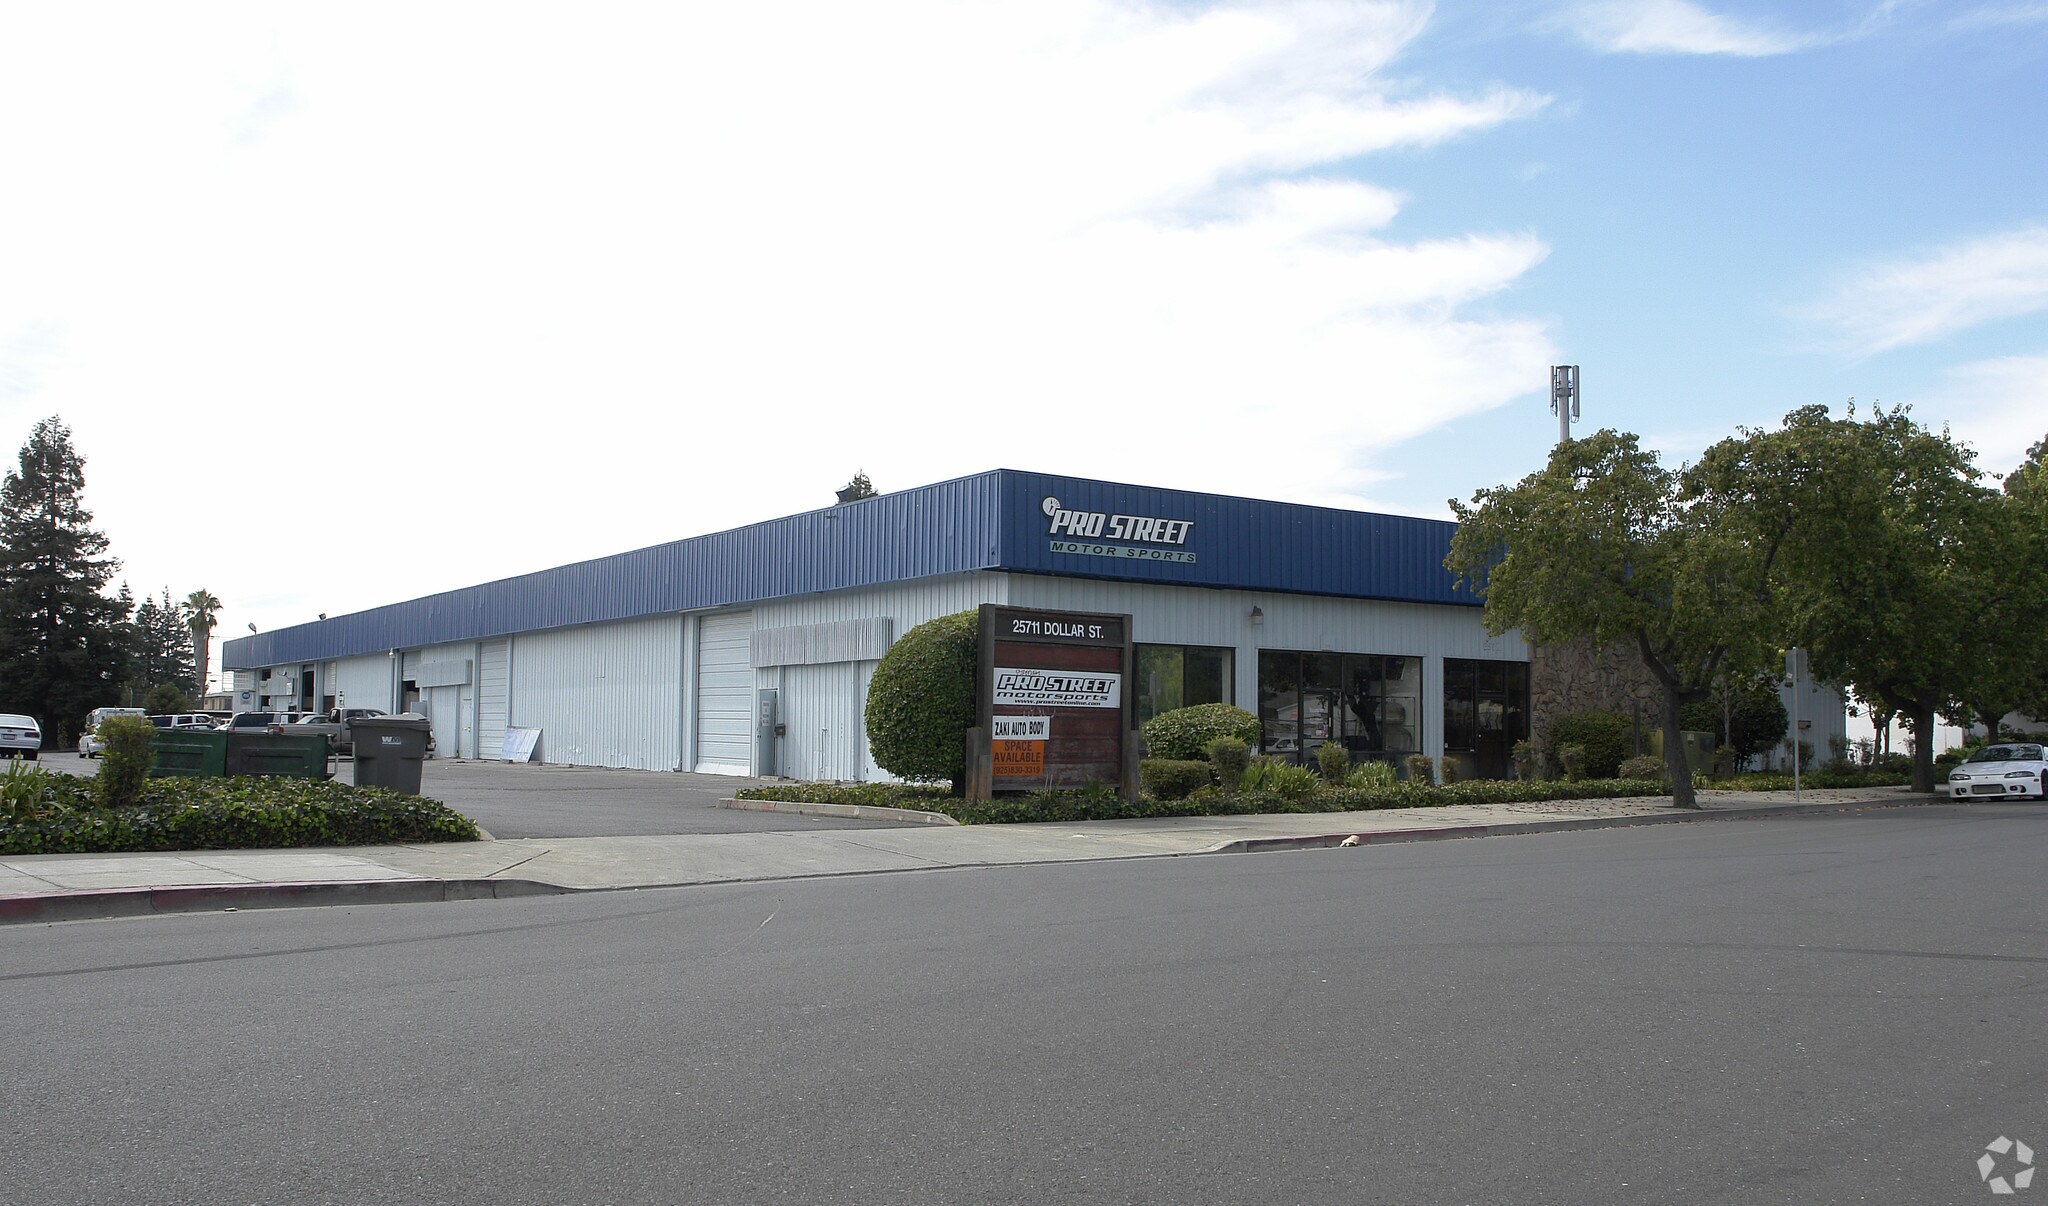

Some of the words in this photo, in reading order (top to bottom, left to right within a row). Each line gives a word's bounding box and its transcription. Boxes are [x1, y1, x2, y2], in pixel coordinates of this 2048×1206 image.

[1050, 509, 1106, 537] PRO
[1106, 514, 1194, 545] STREET
[1051, 542, 1116, 555] MOTOR
[1126, 549, 1195, 562] SPORTS
[1012, 619, 1040, 635] 25711
[1044, 621, 1085, 638] DOLLAR
[1088, 625, 1104, 639] ST.
[996, 691, 1109, 701] motorsports
[995, 721, 1010, 736] ZAKI
[1011, 721, 1027, 736] AUTO
[1029, 720, 1045, 735] BODY
[1004, 740, 1033, 751] SPACE
[993, 752, 1041, 763] AVAILABLE
